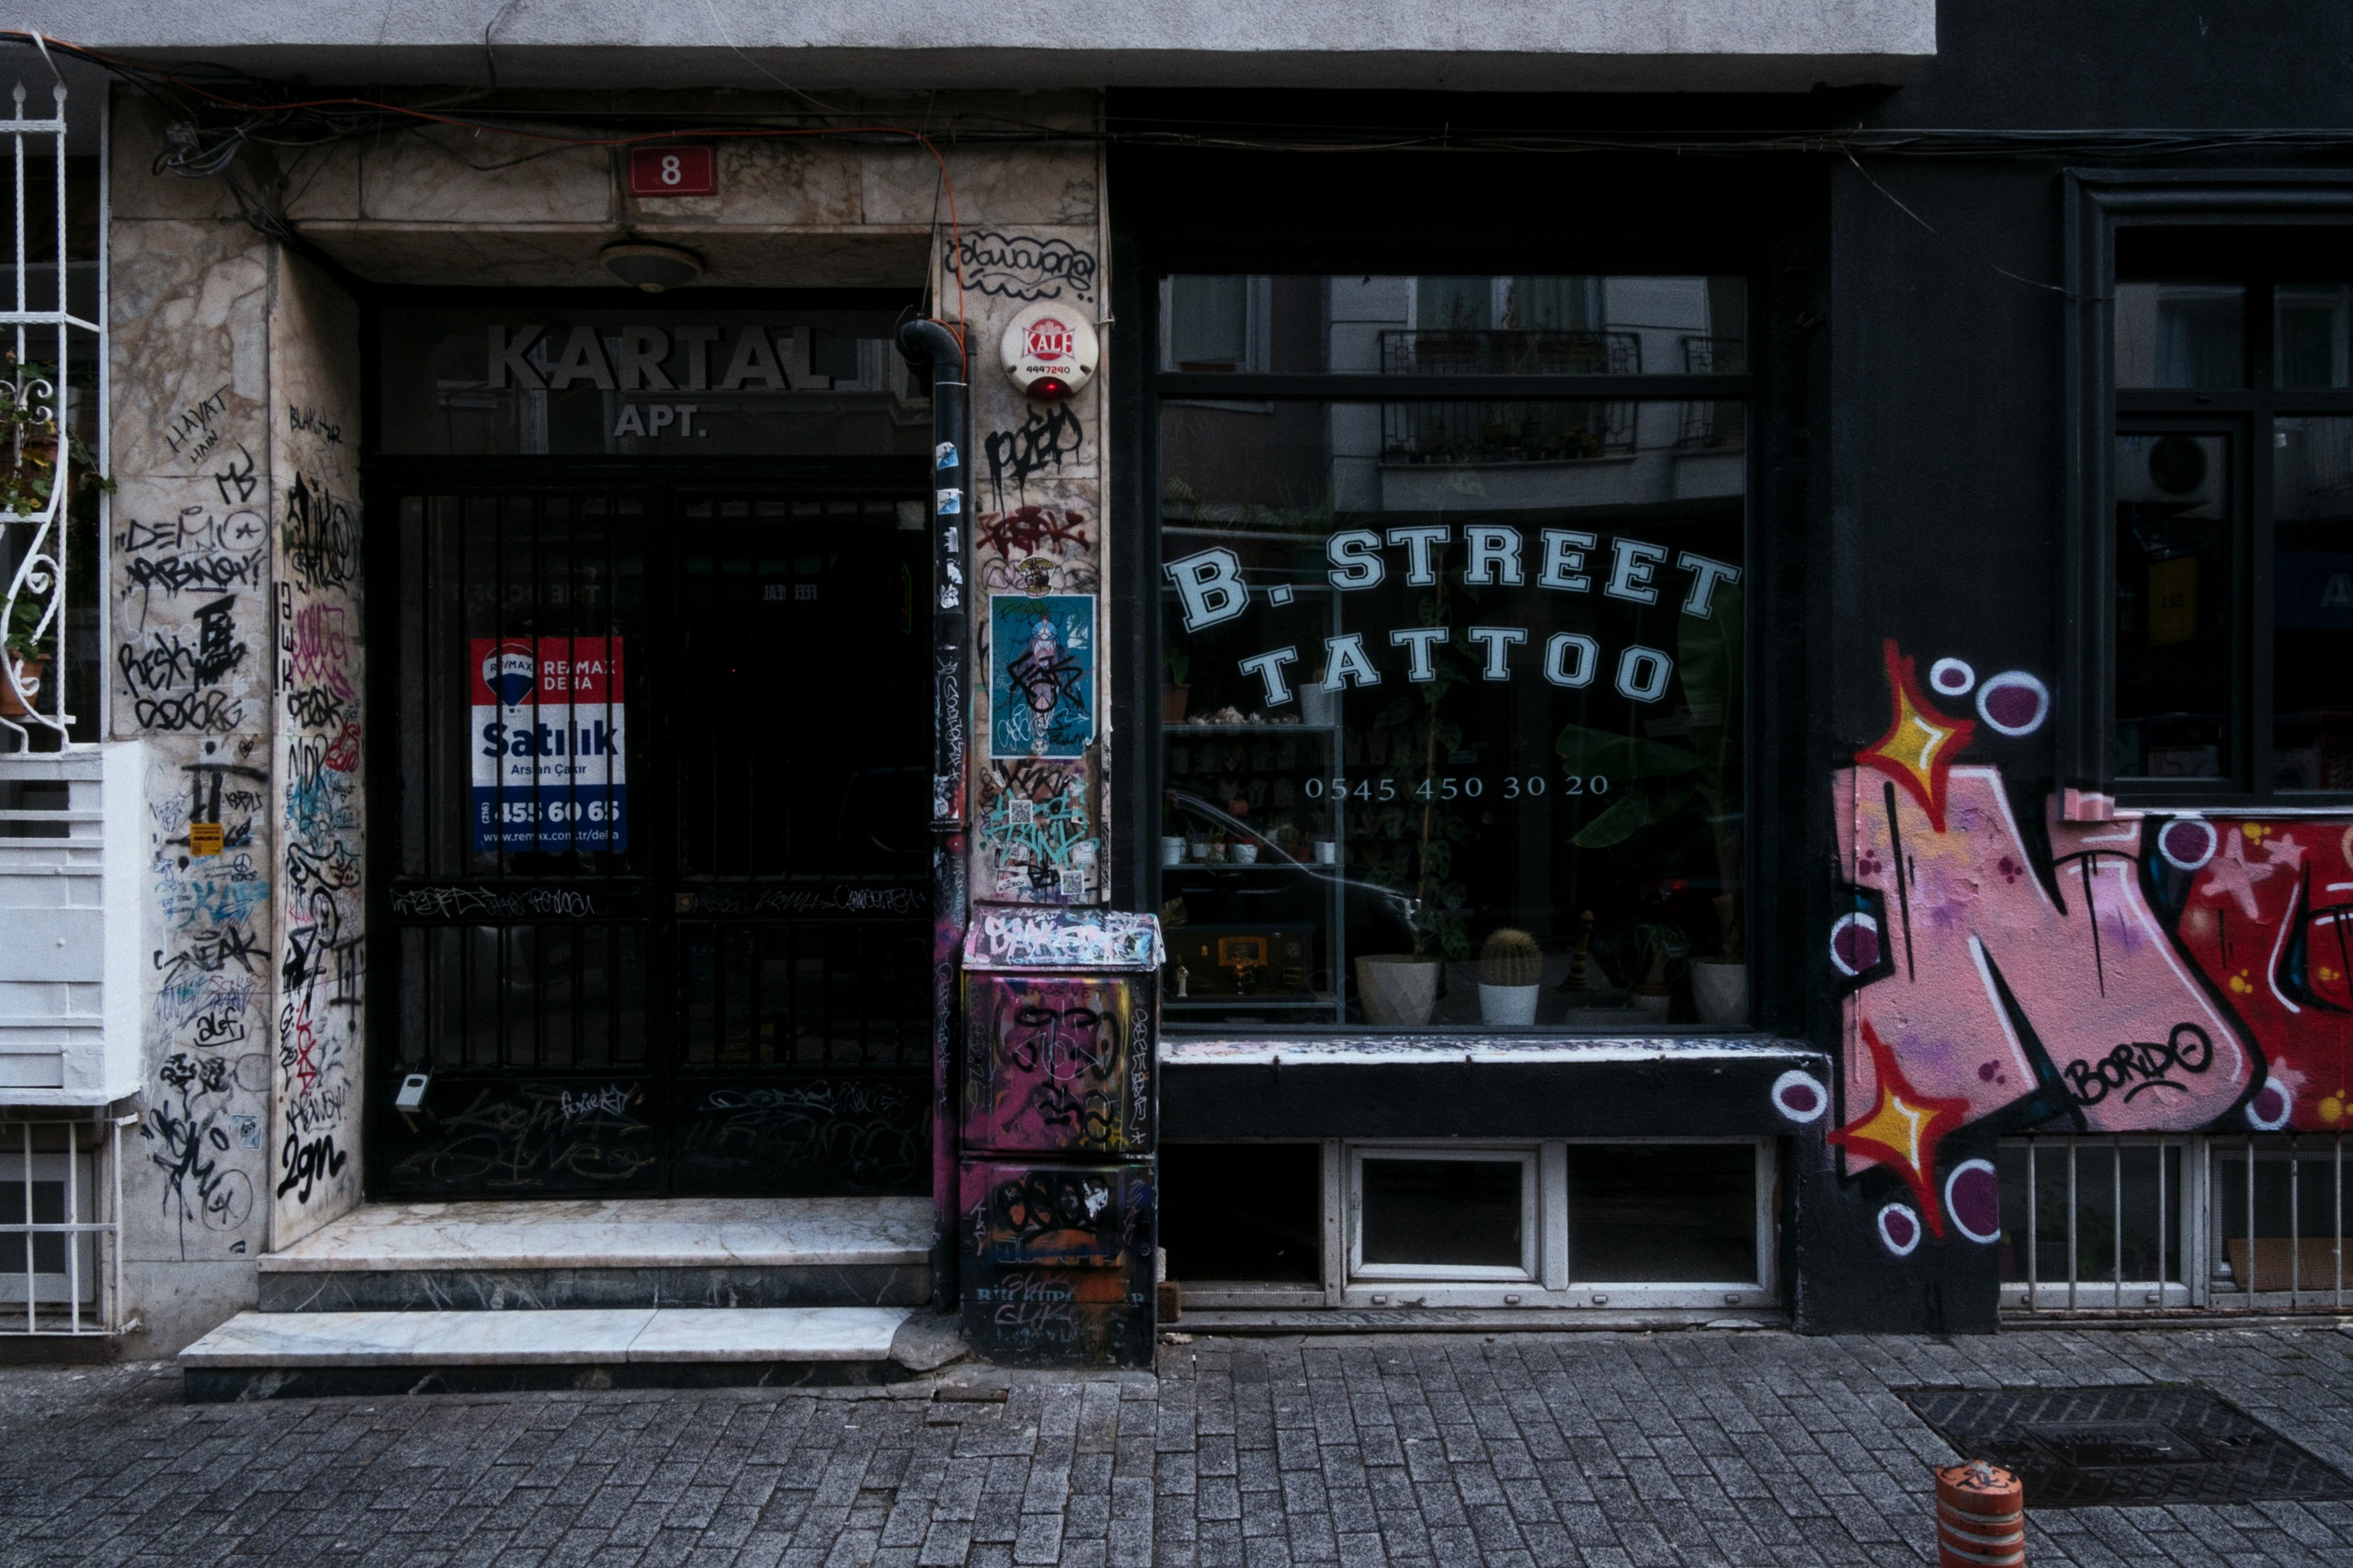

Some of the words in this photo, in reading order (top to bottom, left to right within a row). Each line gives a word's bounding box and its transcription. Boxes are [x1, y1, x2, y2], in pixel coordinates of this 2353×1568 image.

[662, 154, 681, 185] 8
[488, 325, 834, 391] KARTAL
[1023, 329, 1074, 358] KALE
[1026, 365, 1071, 374] 4447240
[166, 383, 229, 452] HAYAT
[614, 404, 708, 437] APT.
[1163, 546, 1294, 634] B.
[1326, 525, 1743, 621] STREET
[1238, 627, 1675, 708] TATTOO
[511, 764, 551, 775] Arsan
[1305, 777, 1396, 801] 0545
[1415, 776, 1484, 801] 450
[1504, 775, 1547, 799] 30
[1565, 774, 1609, 797] 20
[494, 801, 543, 824] 455
[548, 801, 583, 823] 60
[587, 800, 620, 823] 65
